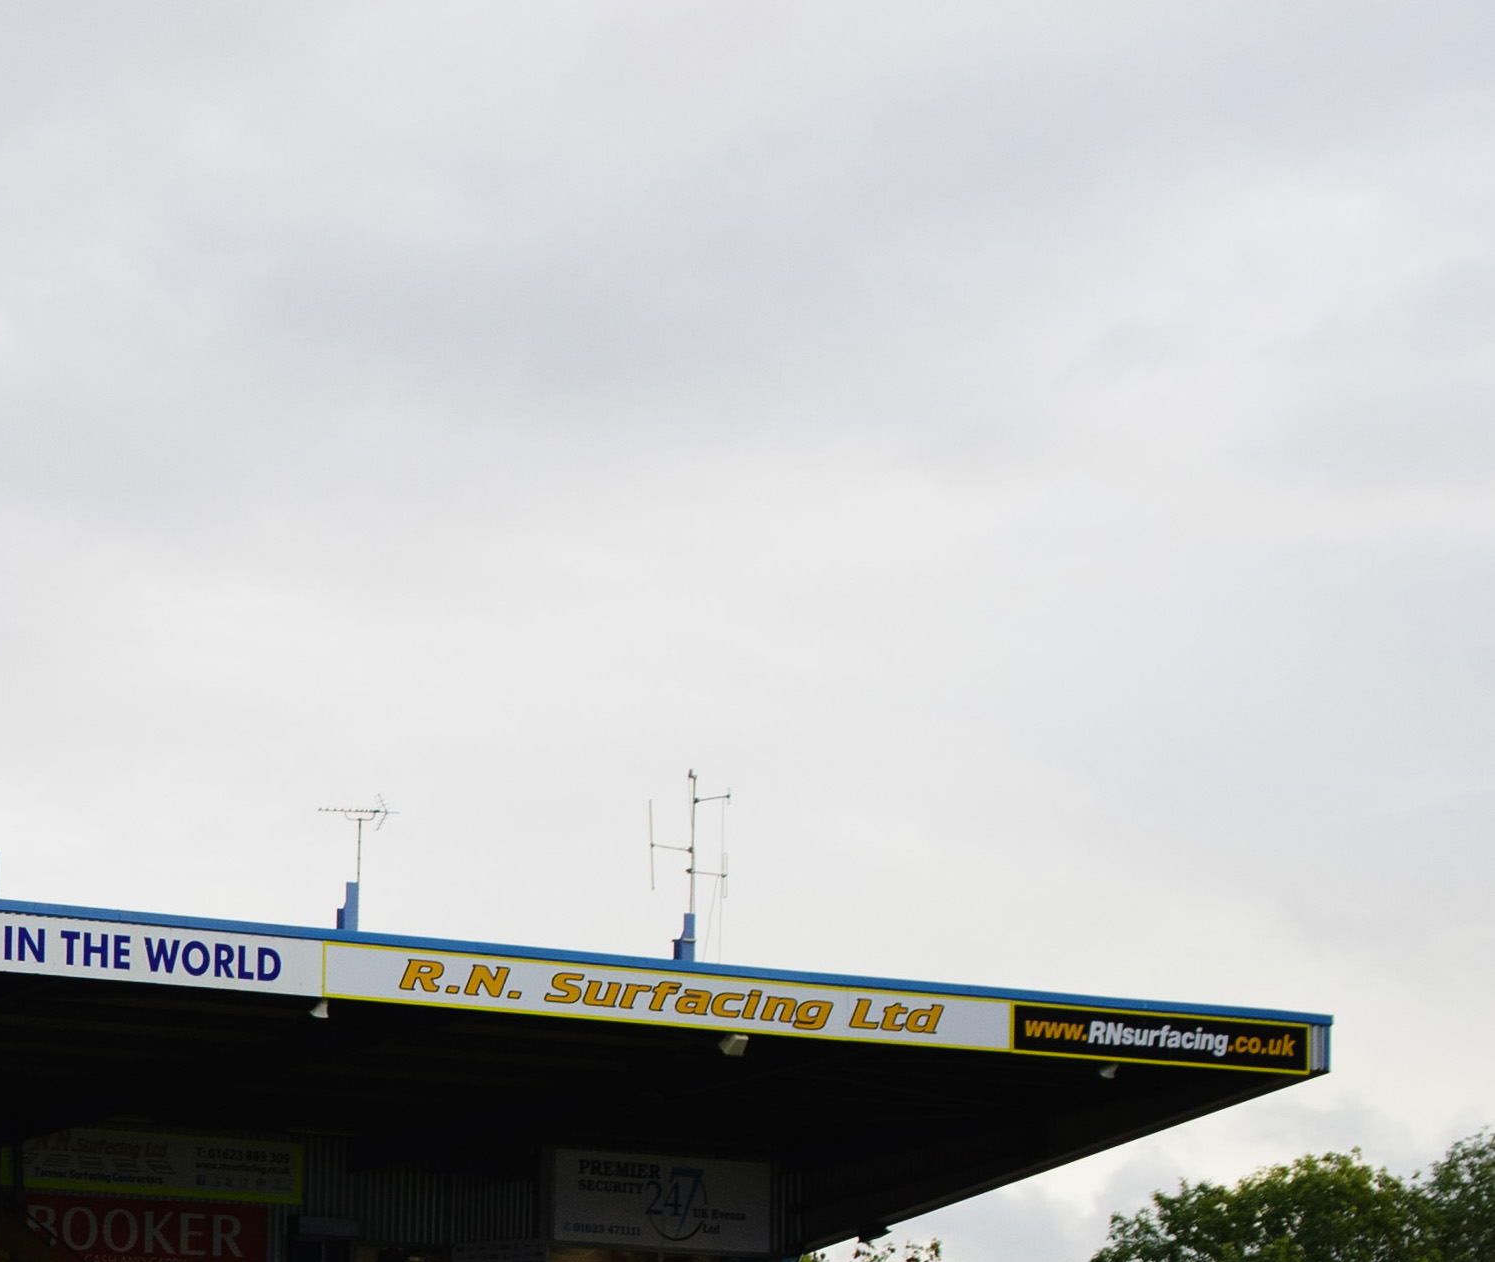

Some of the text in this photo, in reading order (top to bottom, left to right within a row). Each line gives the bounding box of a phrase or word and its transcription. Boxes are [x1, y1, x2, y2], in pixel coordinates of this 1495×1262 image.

[4, 925, 44, 962] IN
[61, 930, 130, 970] THE
[145, 937, 281, 982] WORLD
[400, 959, 944, 1034] R.N. Surfacing Ltd
[1025, 1020, 1295, 1057] www.RNsurfacing.co.uk
[209, 1147, 242, 1161] 01623
[245, 1150, 267, 1162] 889
[578, 1159, 661, 1179] PREMIER
[578, 1179, 644, 1194] SECURITY
[693, 1208, 746, 1221] UK Events
[26, 1204, 244, 1258] BOOKER
